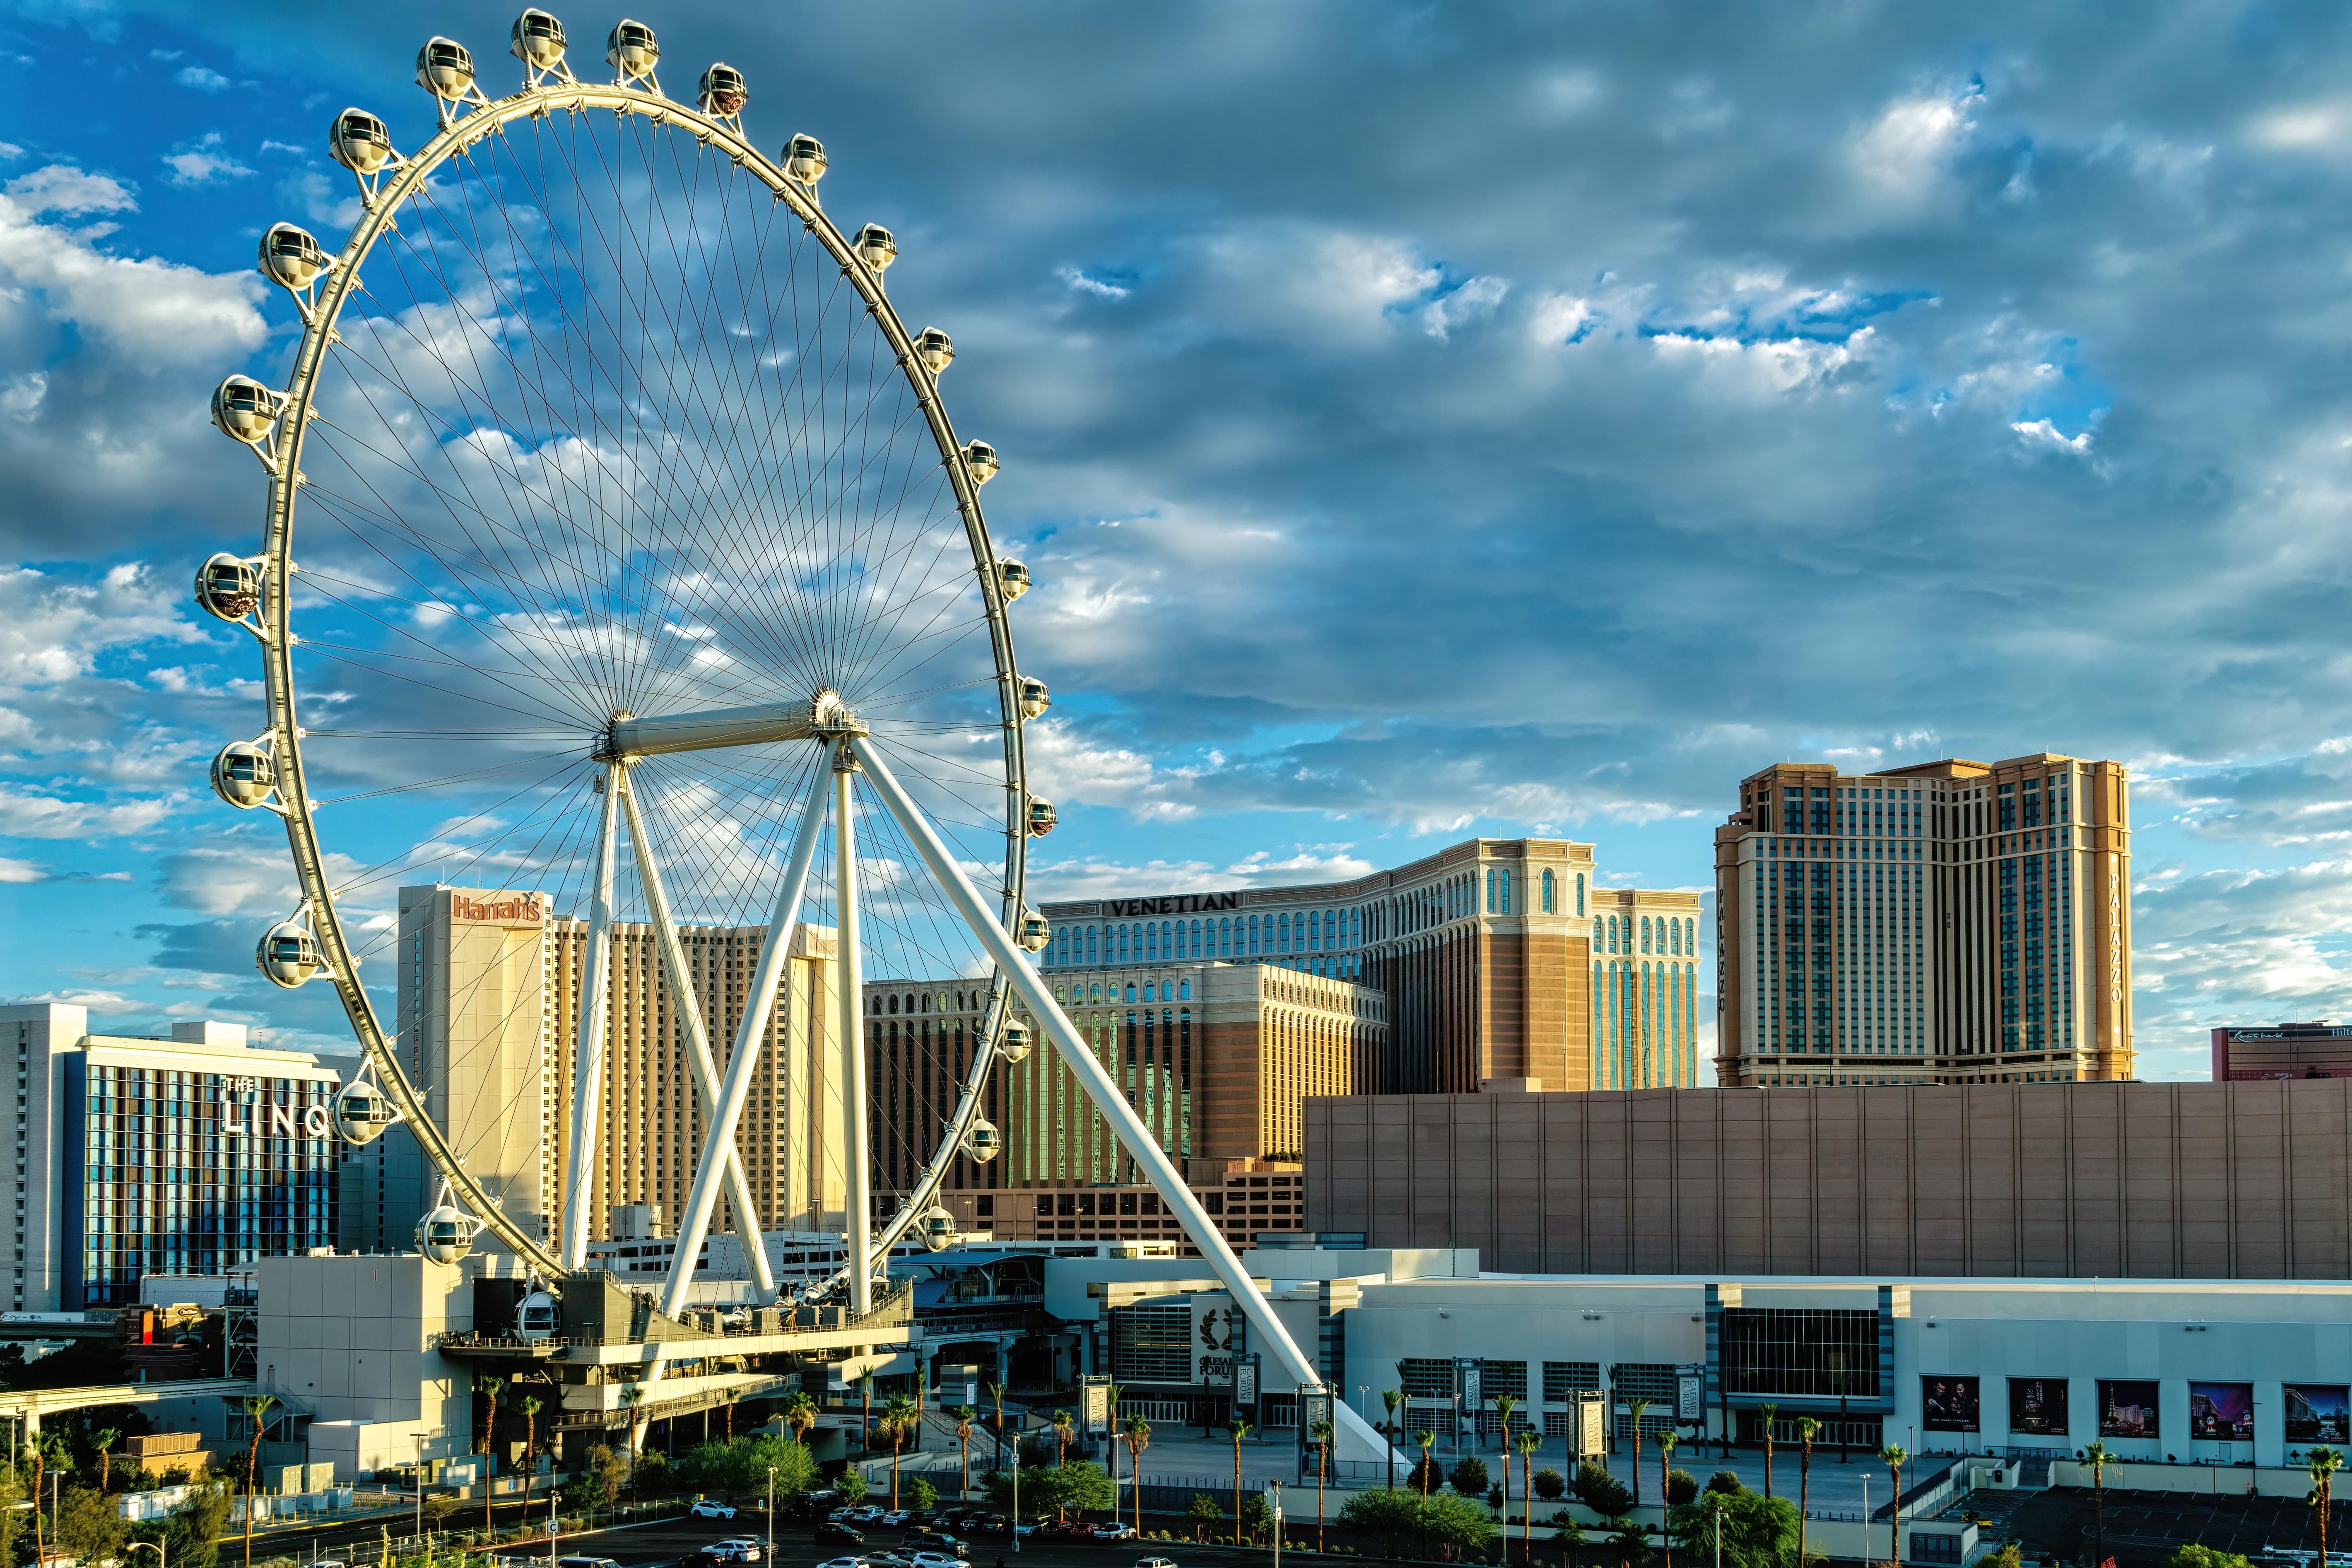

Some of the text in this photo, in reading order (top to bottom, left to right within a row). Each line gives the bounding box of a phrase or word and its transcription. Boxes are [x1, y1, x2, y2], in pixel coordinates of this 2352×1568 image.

[720, 92, 734, 104] HIGH
[219, 593, 239, 607] HIGH
[1110, 892, 1236, 917] VENETIAN
[2111, 874, 2121, 1002] PALAZZO
[2234, 1030, 2258, 1042] Resorts
[226, 1077, 254, 1093] THE
[225, 1100, 331, 1137] LINQ
[1199, 1357, 1232, 1366] CAESA
[1200, 1366, 1232, 1375] FORU
